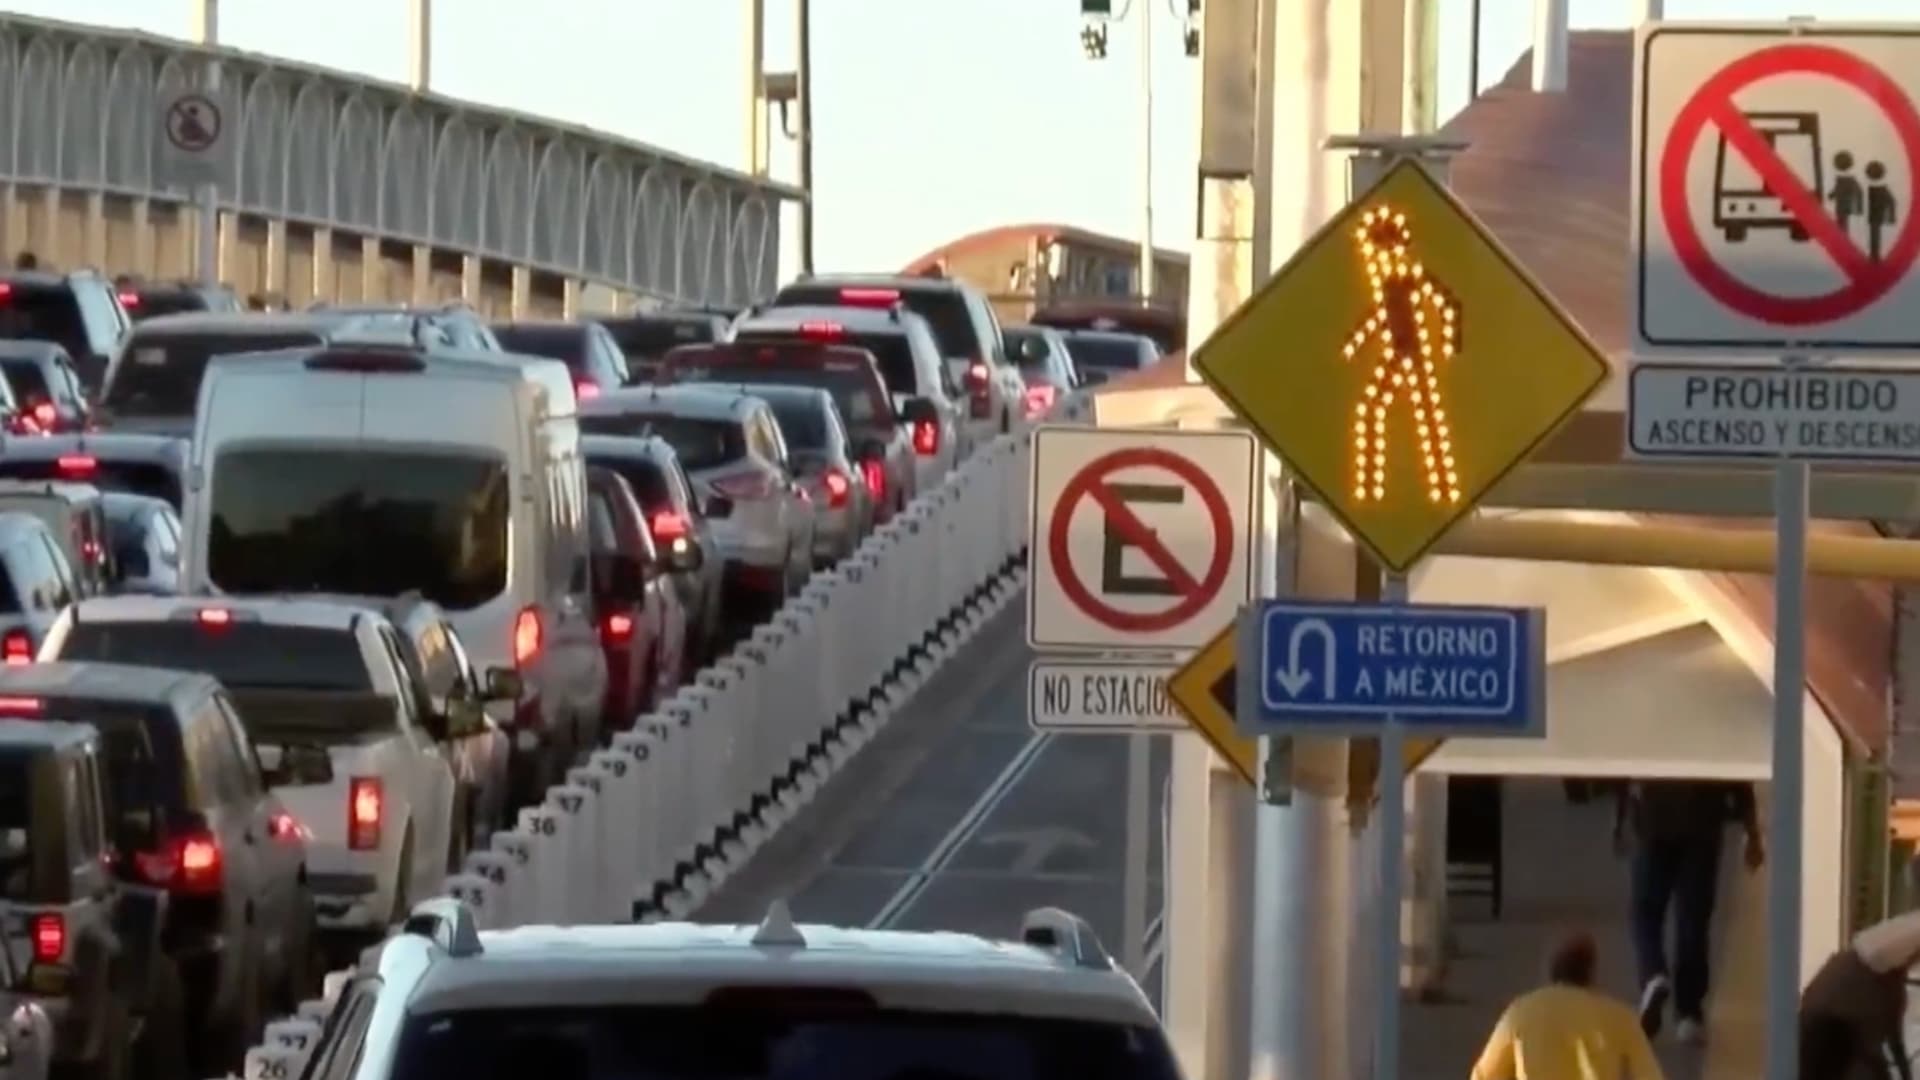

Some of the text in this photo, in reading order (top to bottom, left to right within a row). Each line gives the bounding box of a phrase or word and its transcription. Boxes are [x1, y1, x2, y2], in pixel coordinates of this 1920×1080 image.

[1685, 375, 1898, 413] PROHIBIDO
[1647, 418, 1920, 449] ASCENSO Y DESCENS
[1357, 625, 1498, 656] RETORNO
[1043, 674, 1071, 715] NO
[1354, 661, 1499, 698] A MÉXICO
[530, 817, 556, 836] 36
[257, 1056, 288, 1079] 26
